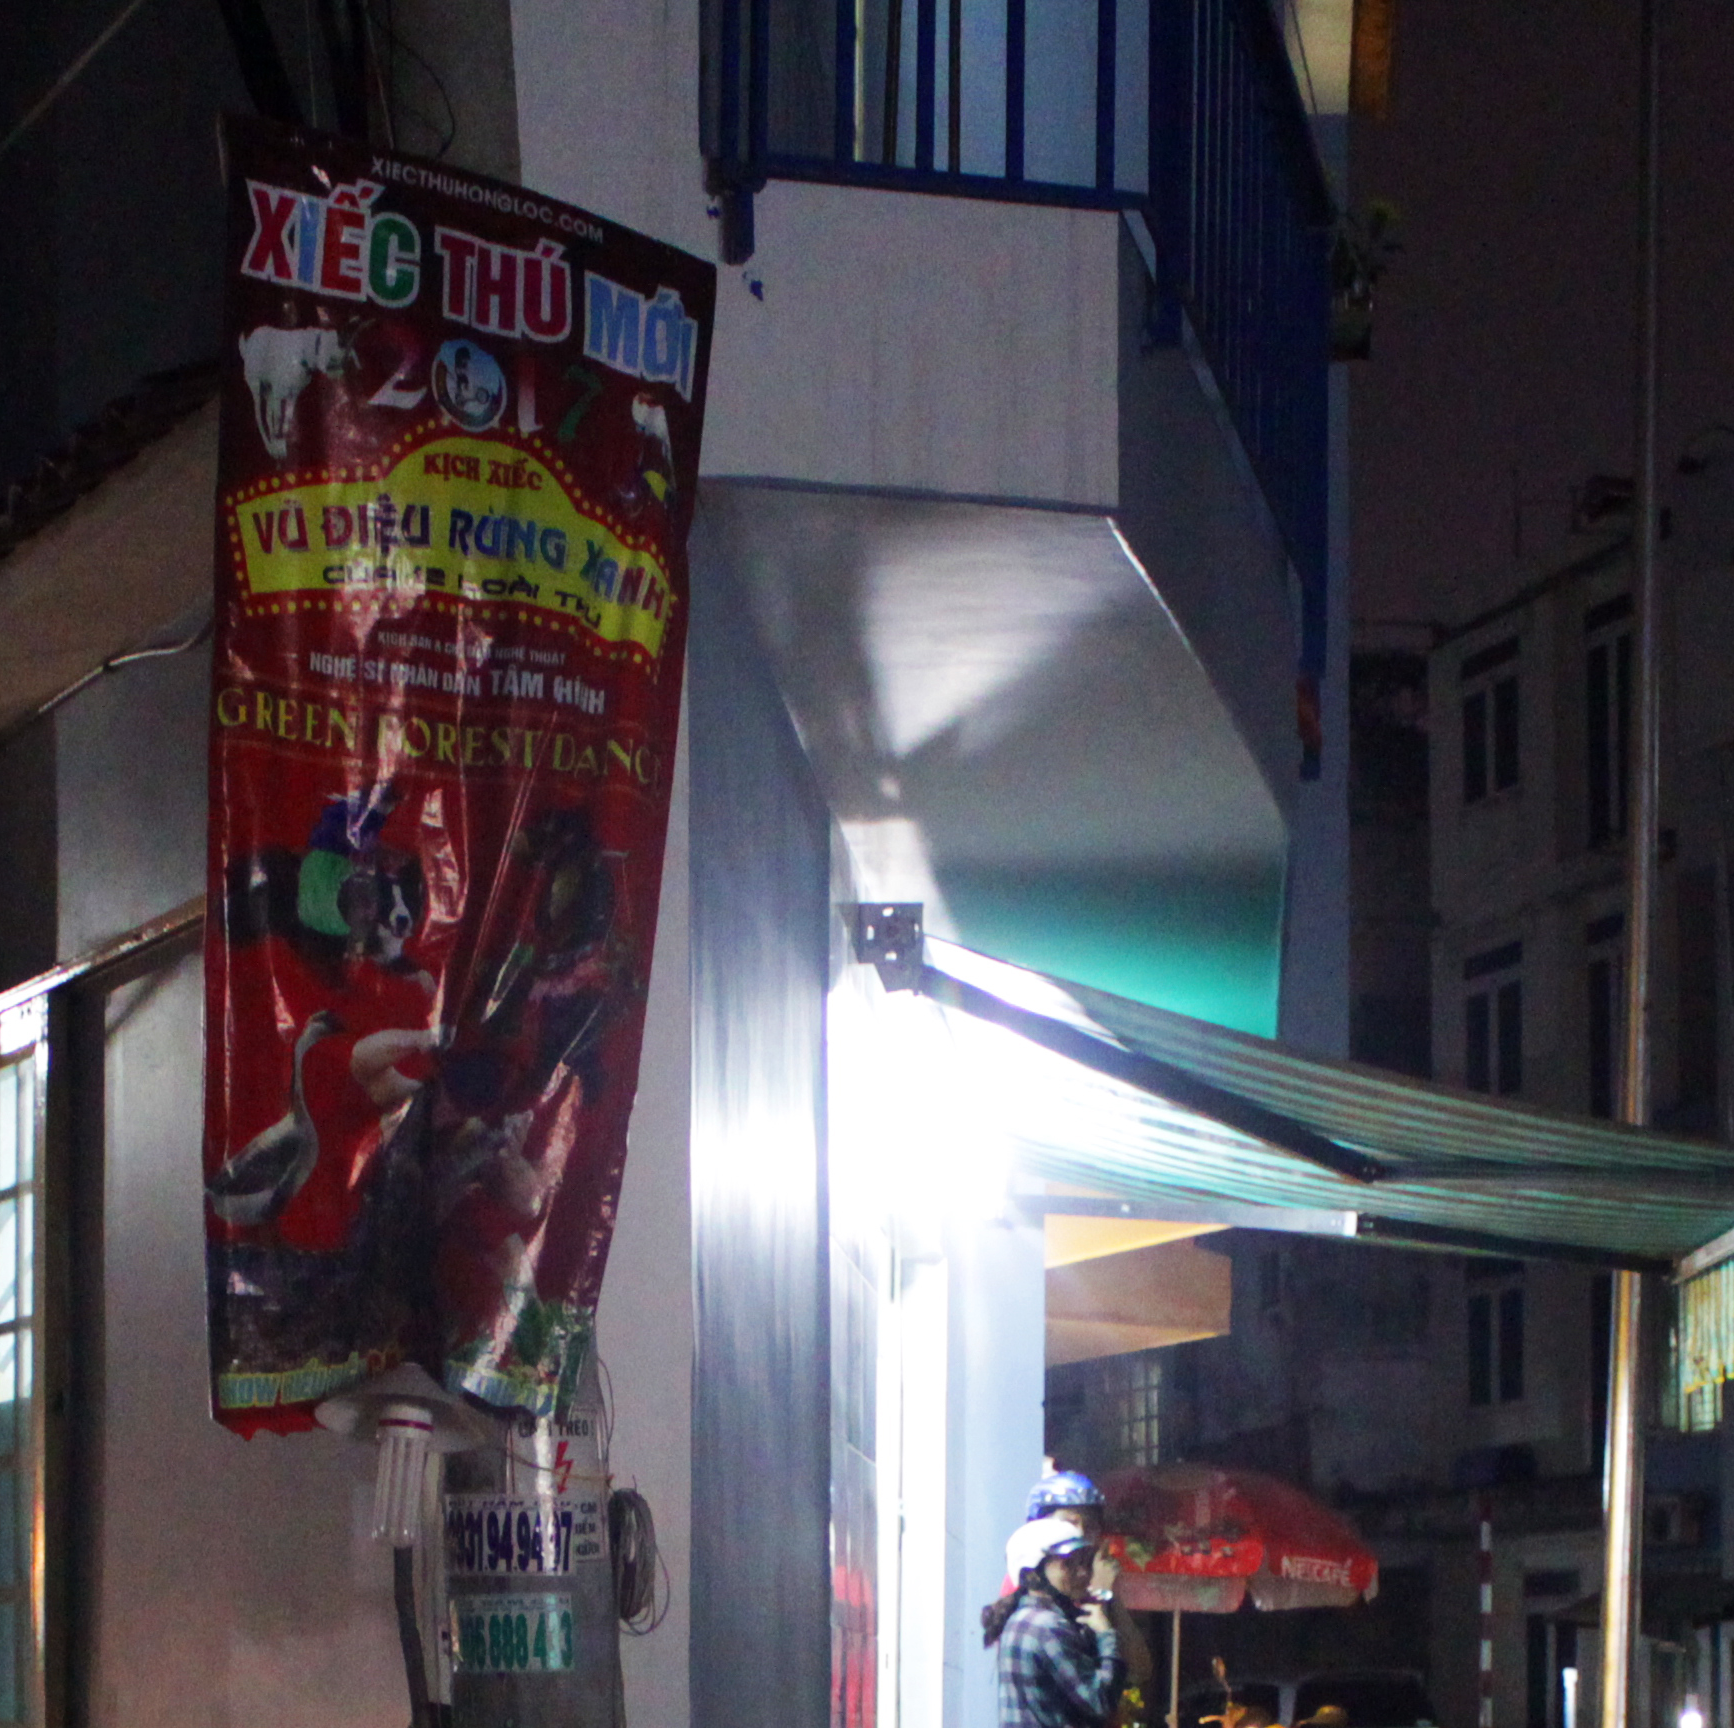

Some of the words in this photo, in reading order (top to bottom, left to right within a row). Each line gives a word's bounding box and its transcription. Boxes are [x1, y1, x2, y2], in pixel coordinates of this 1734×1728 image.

[370, 155, 604, 244] XIECTHUHONGLOC.COM
[241, 177, 421, 308] XIẾC
[434, 225, 572, 343] THÚ
[583, 271, 698, 402] MỚI
[487, 459, 543, 490] XIẾC
[253, 500, 309, 554] VŨ
[321, 493, 431, 557] ĐIỆU
[448, 504, 568, 570] RỪNG
[581, 538, 668, 621] XANH
[489, 665, 546, 700] TÂM
[214, 687, 357, 750] GREEN
[376, 711, 540, 769] FOREST
[550, 732, 661, 793] DANC
[533, 1609, 573, 1669] 43
